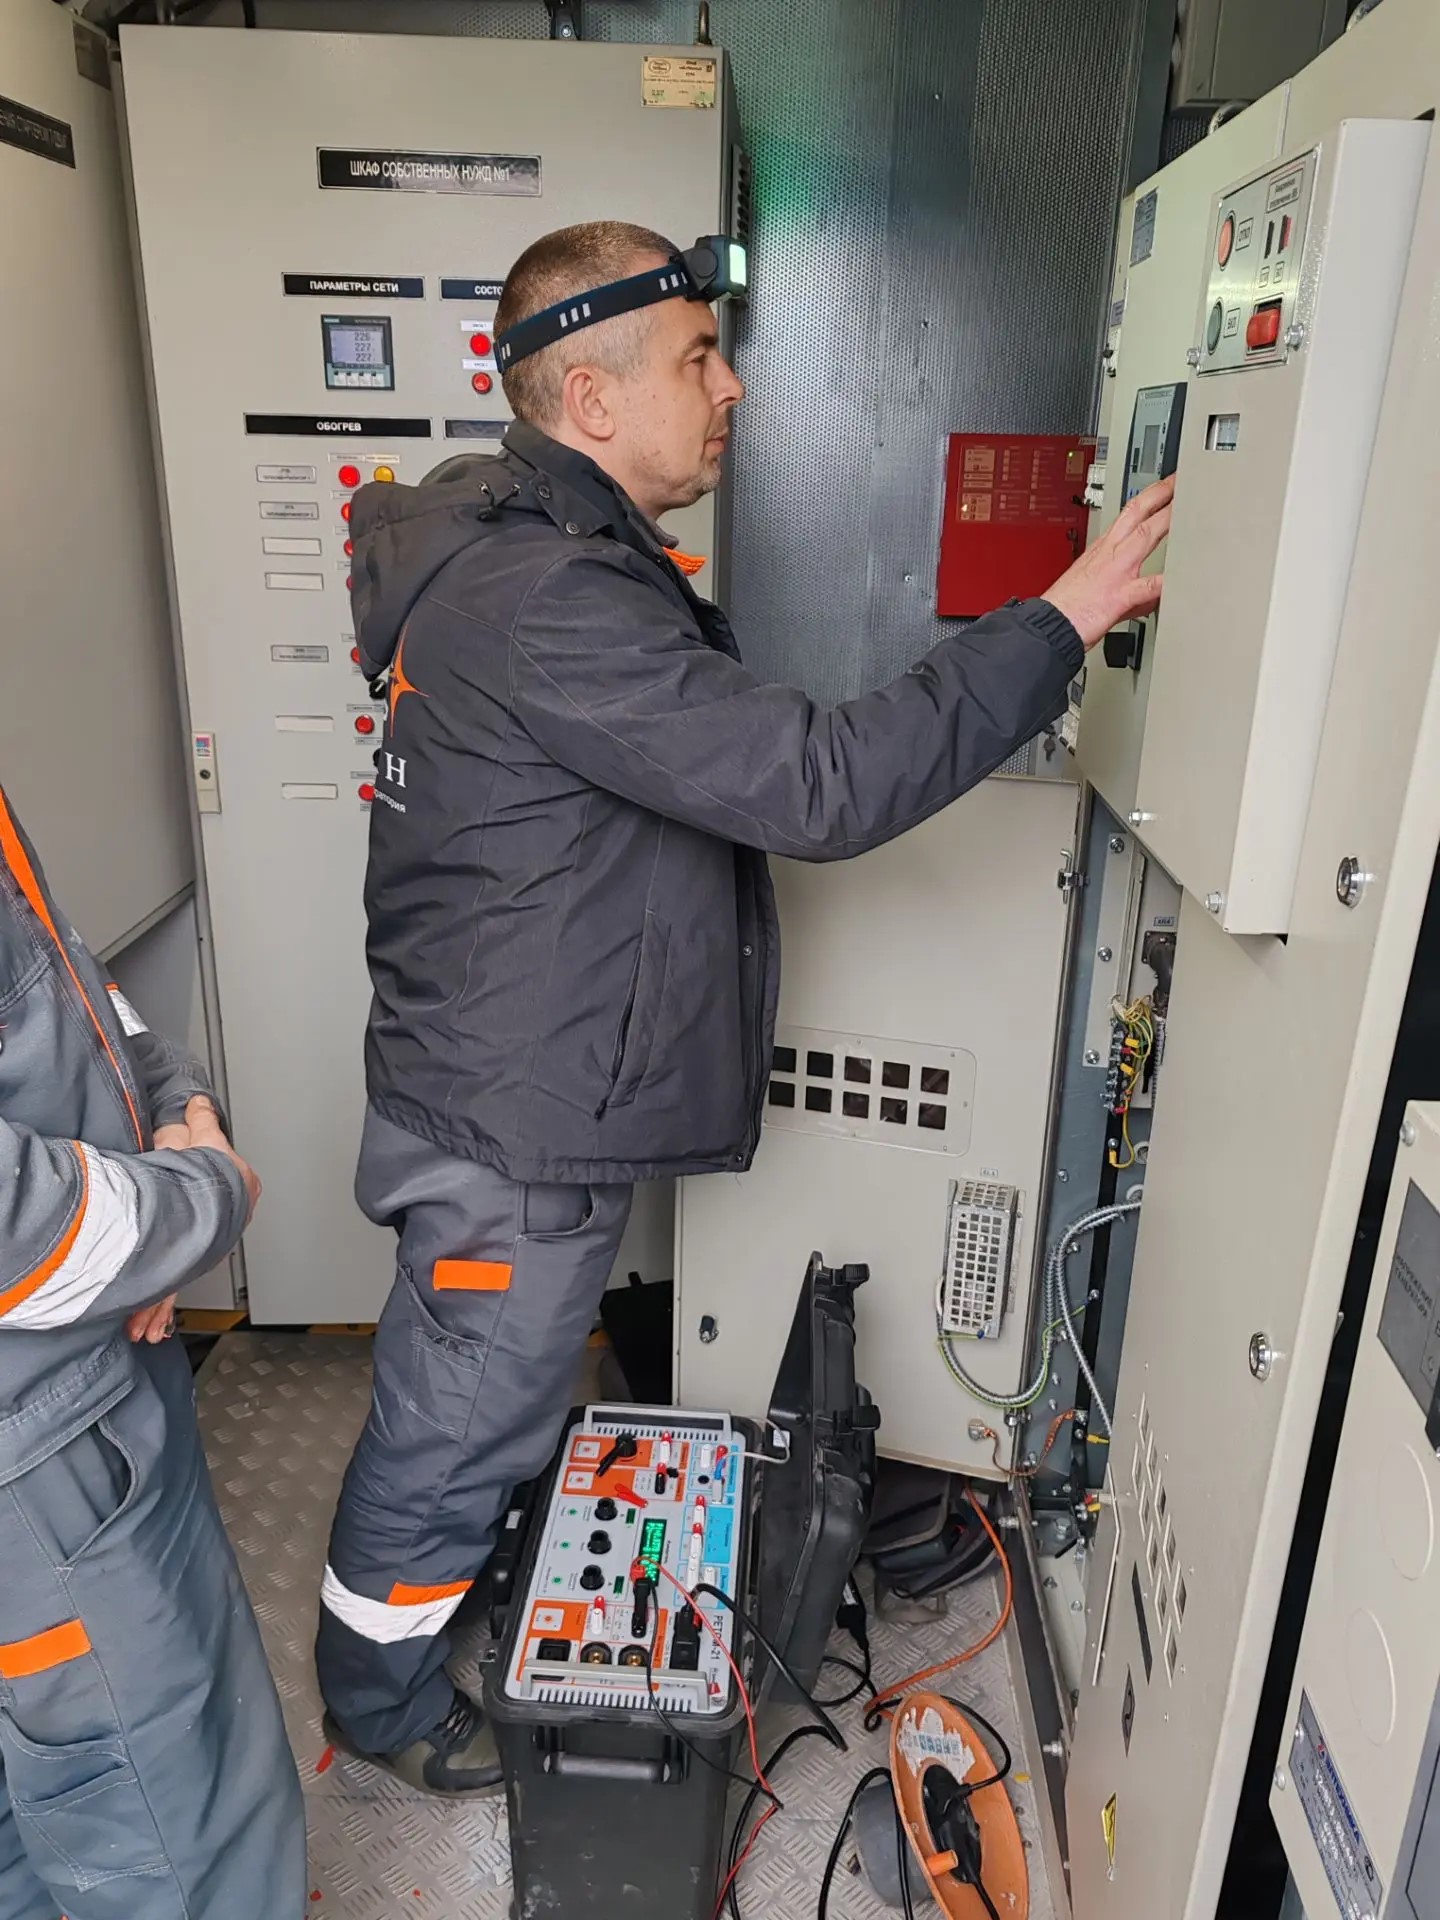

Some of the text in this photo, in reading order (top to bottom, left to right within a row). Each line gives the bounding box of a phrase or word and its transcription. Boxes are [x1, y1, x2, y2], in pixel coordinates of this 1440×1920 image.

[349, 160, 510, 183] ШКАФ СОБСТВЕННЫХ НУЖД №1
[309, 280, 399, 293] ПАРАМЕТРЫ СЕТИ
[474, 285, 503, 296] СОСТО
[316, 421, 362, 432] ОБОГРЕВ
